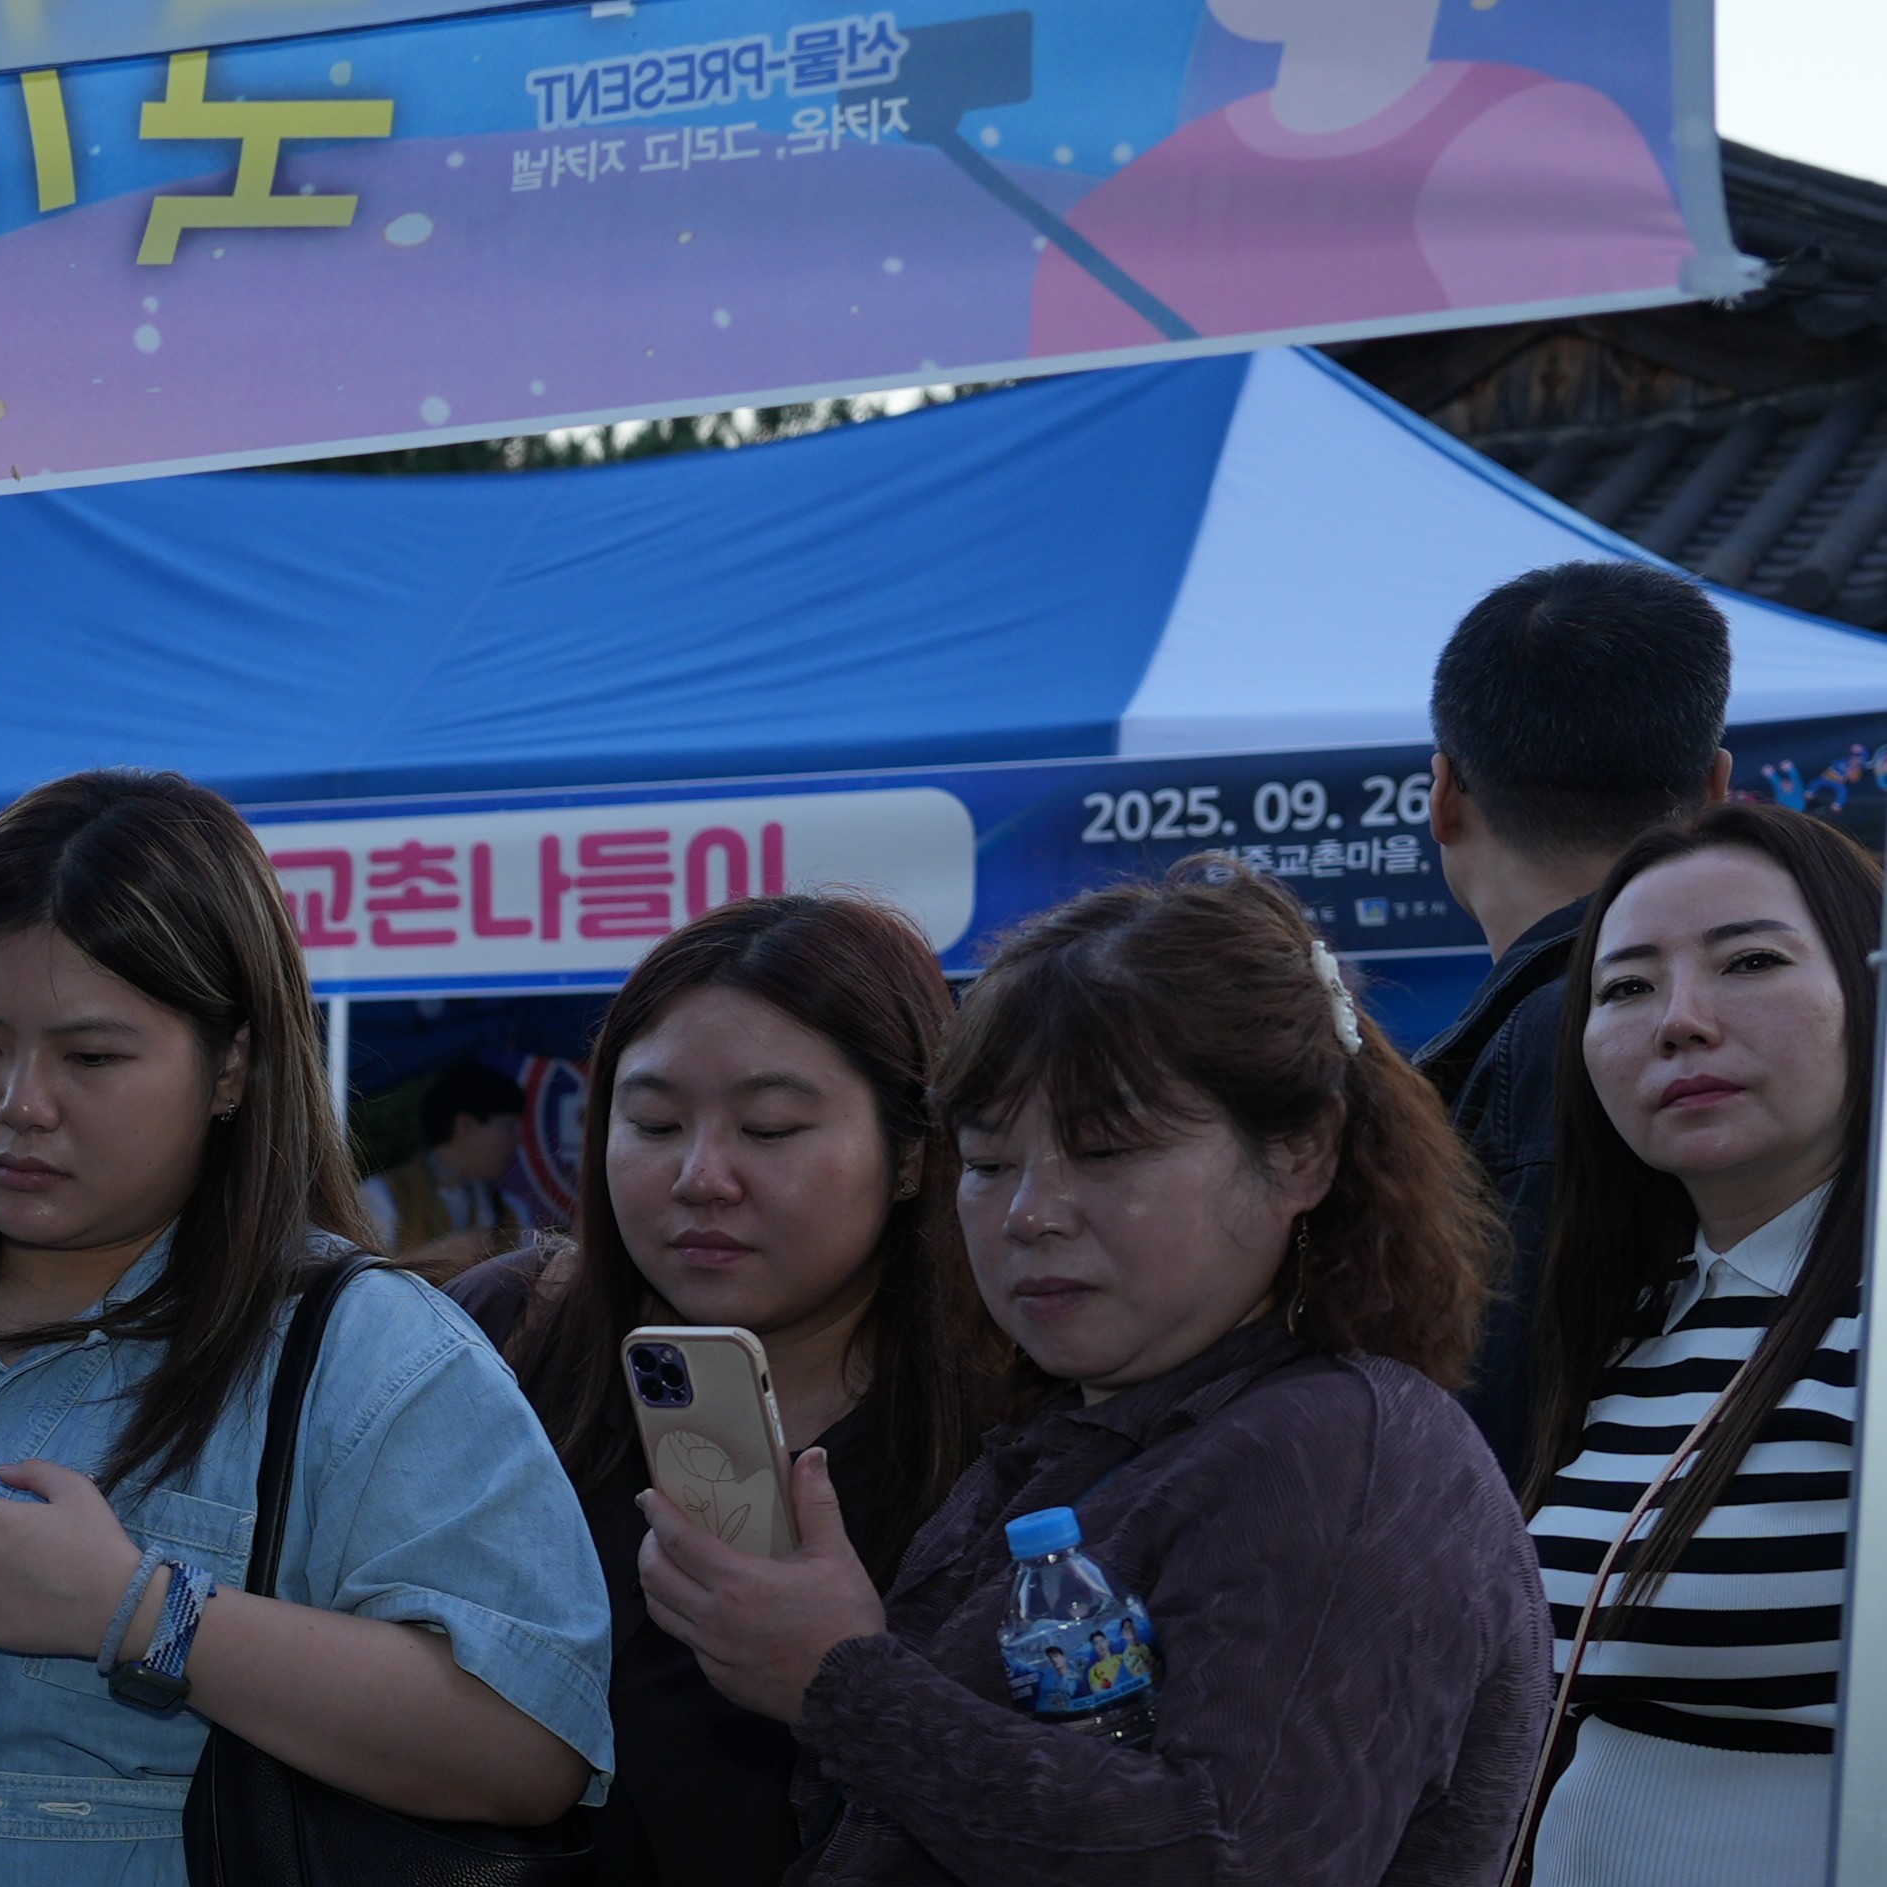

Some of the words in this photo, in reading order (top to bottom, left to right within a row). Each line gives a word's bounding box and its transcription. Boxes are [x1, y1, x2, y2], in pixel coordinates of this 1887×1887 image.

[1081, 786, 1238, 844] 2025.
[1252, 779, 1345, 834] 09.
[266, 822, 784, 948] 교촌나들이
